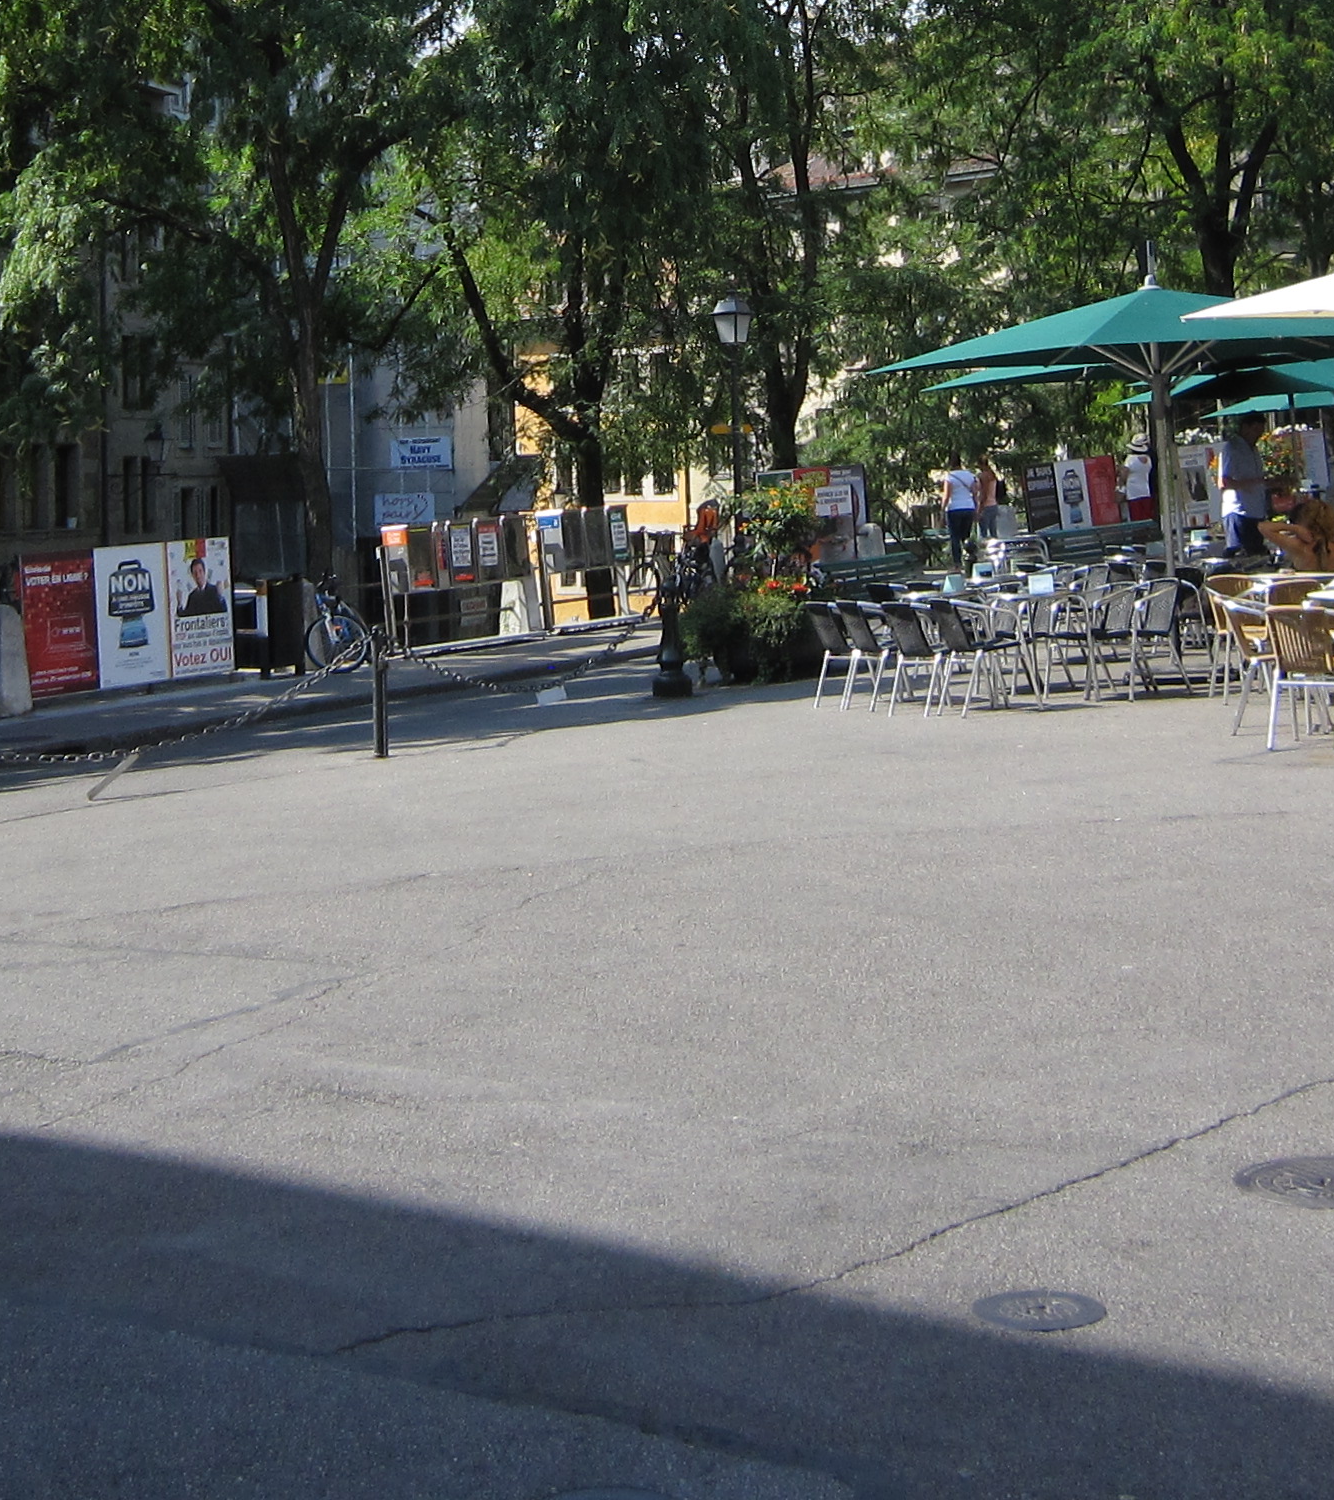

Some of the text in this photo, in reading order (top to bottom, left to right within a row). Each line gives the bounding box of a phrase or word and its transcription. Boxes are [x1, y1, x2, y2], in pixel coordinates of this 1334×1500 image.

[110, 572, 150, 594] NON
[174, 646, 233, 667] Votez OUI
